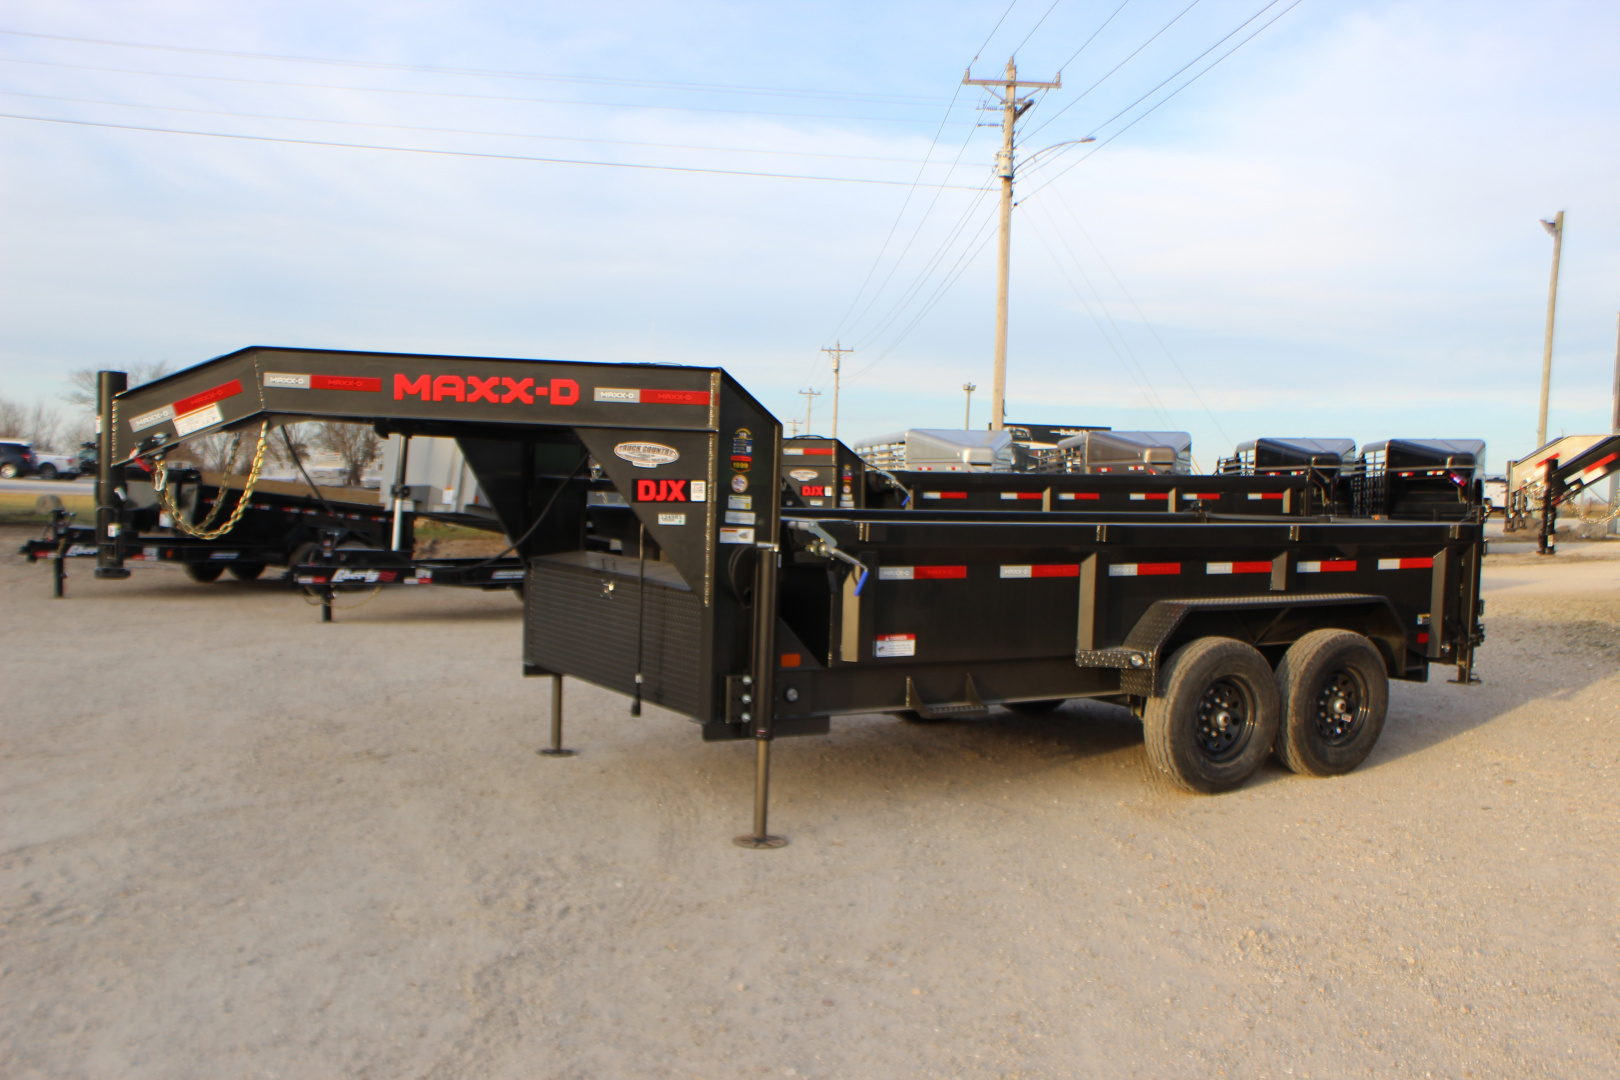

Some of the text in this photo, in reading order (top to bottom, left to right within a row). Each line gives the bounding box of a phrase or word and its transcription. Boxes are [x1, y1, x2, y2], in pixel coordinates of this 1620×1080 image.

[269, 376, 363, 387] MAXX-D MAXX-D
[393, 373, 580, 406] MAXX-D
[600, 391, 692, 401] MAXX-D MAXX-D
[619, 445, 675, 457] TRUCK COUNTRY
[637, 479, 687, 502] DJX
[801, 485, 824, 497] DJX
[331, 568, 381, 583] Liberty
